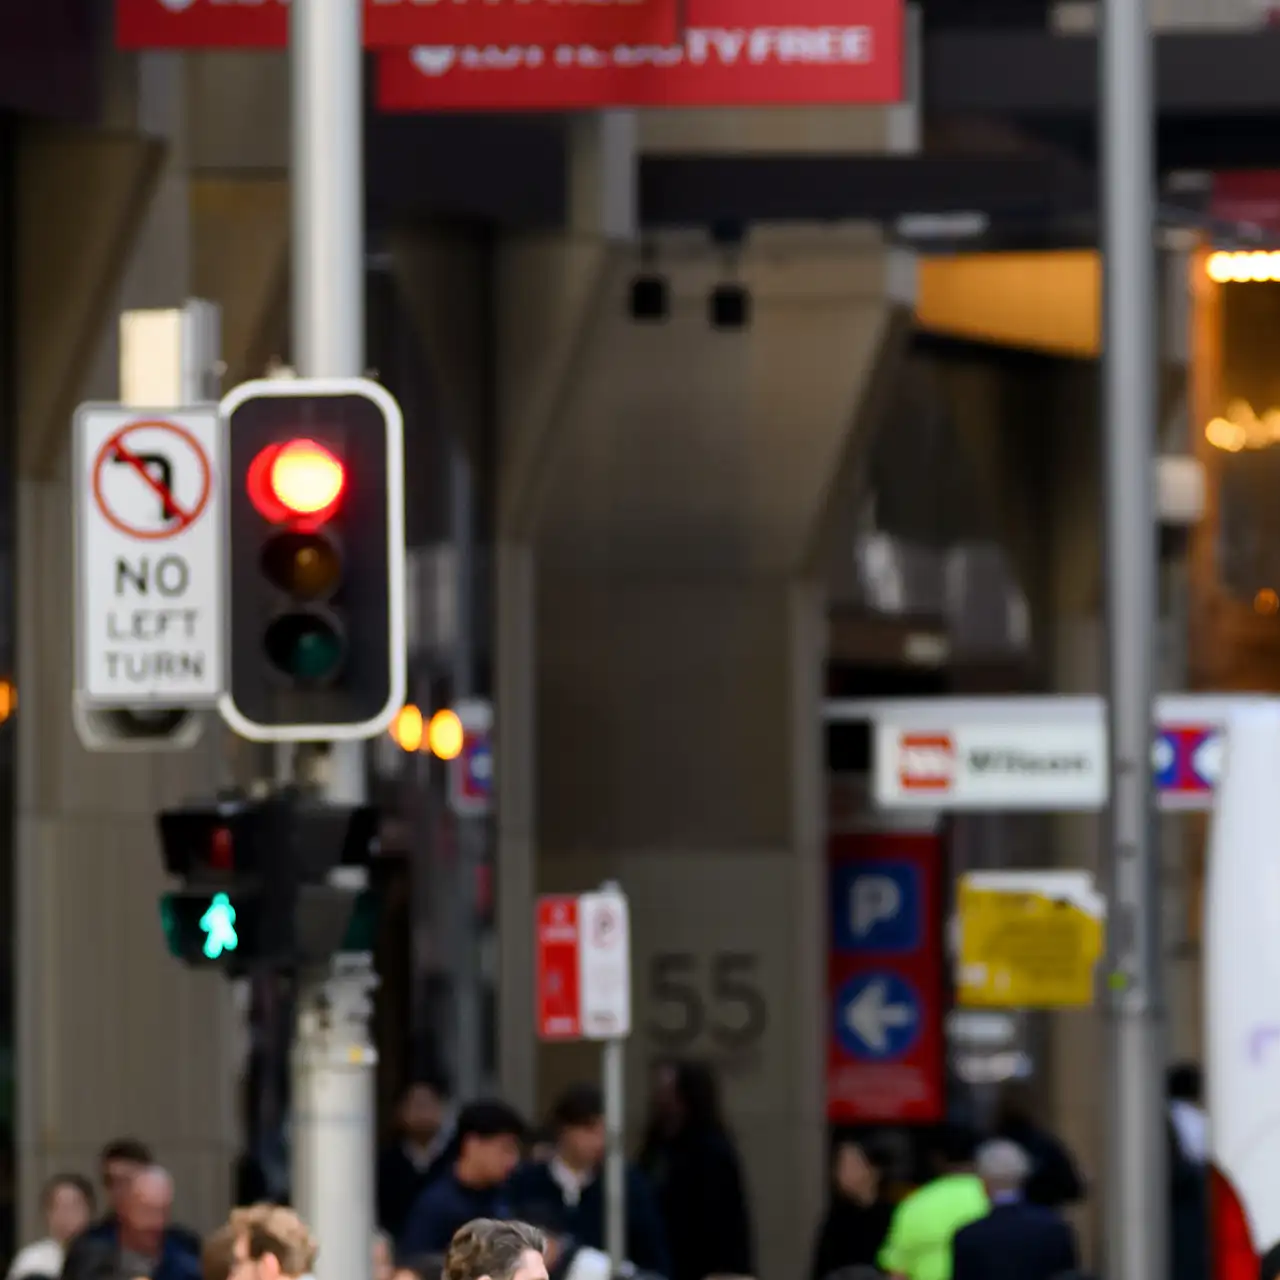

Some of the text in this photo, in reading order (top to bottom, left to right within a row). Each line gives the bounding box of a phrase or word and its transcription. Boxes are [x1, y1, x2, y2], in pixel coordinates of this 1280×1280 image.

[748, 26, 873, 64] FREE
[114, 555, 189, 597] NO
[107, 609, 198, 641] LEFT
[106, 651, 204, 680] TURN
[849, 874, 902, 938] P
[649, 951, 768, 1046] 55
